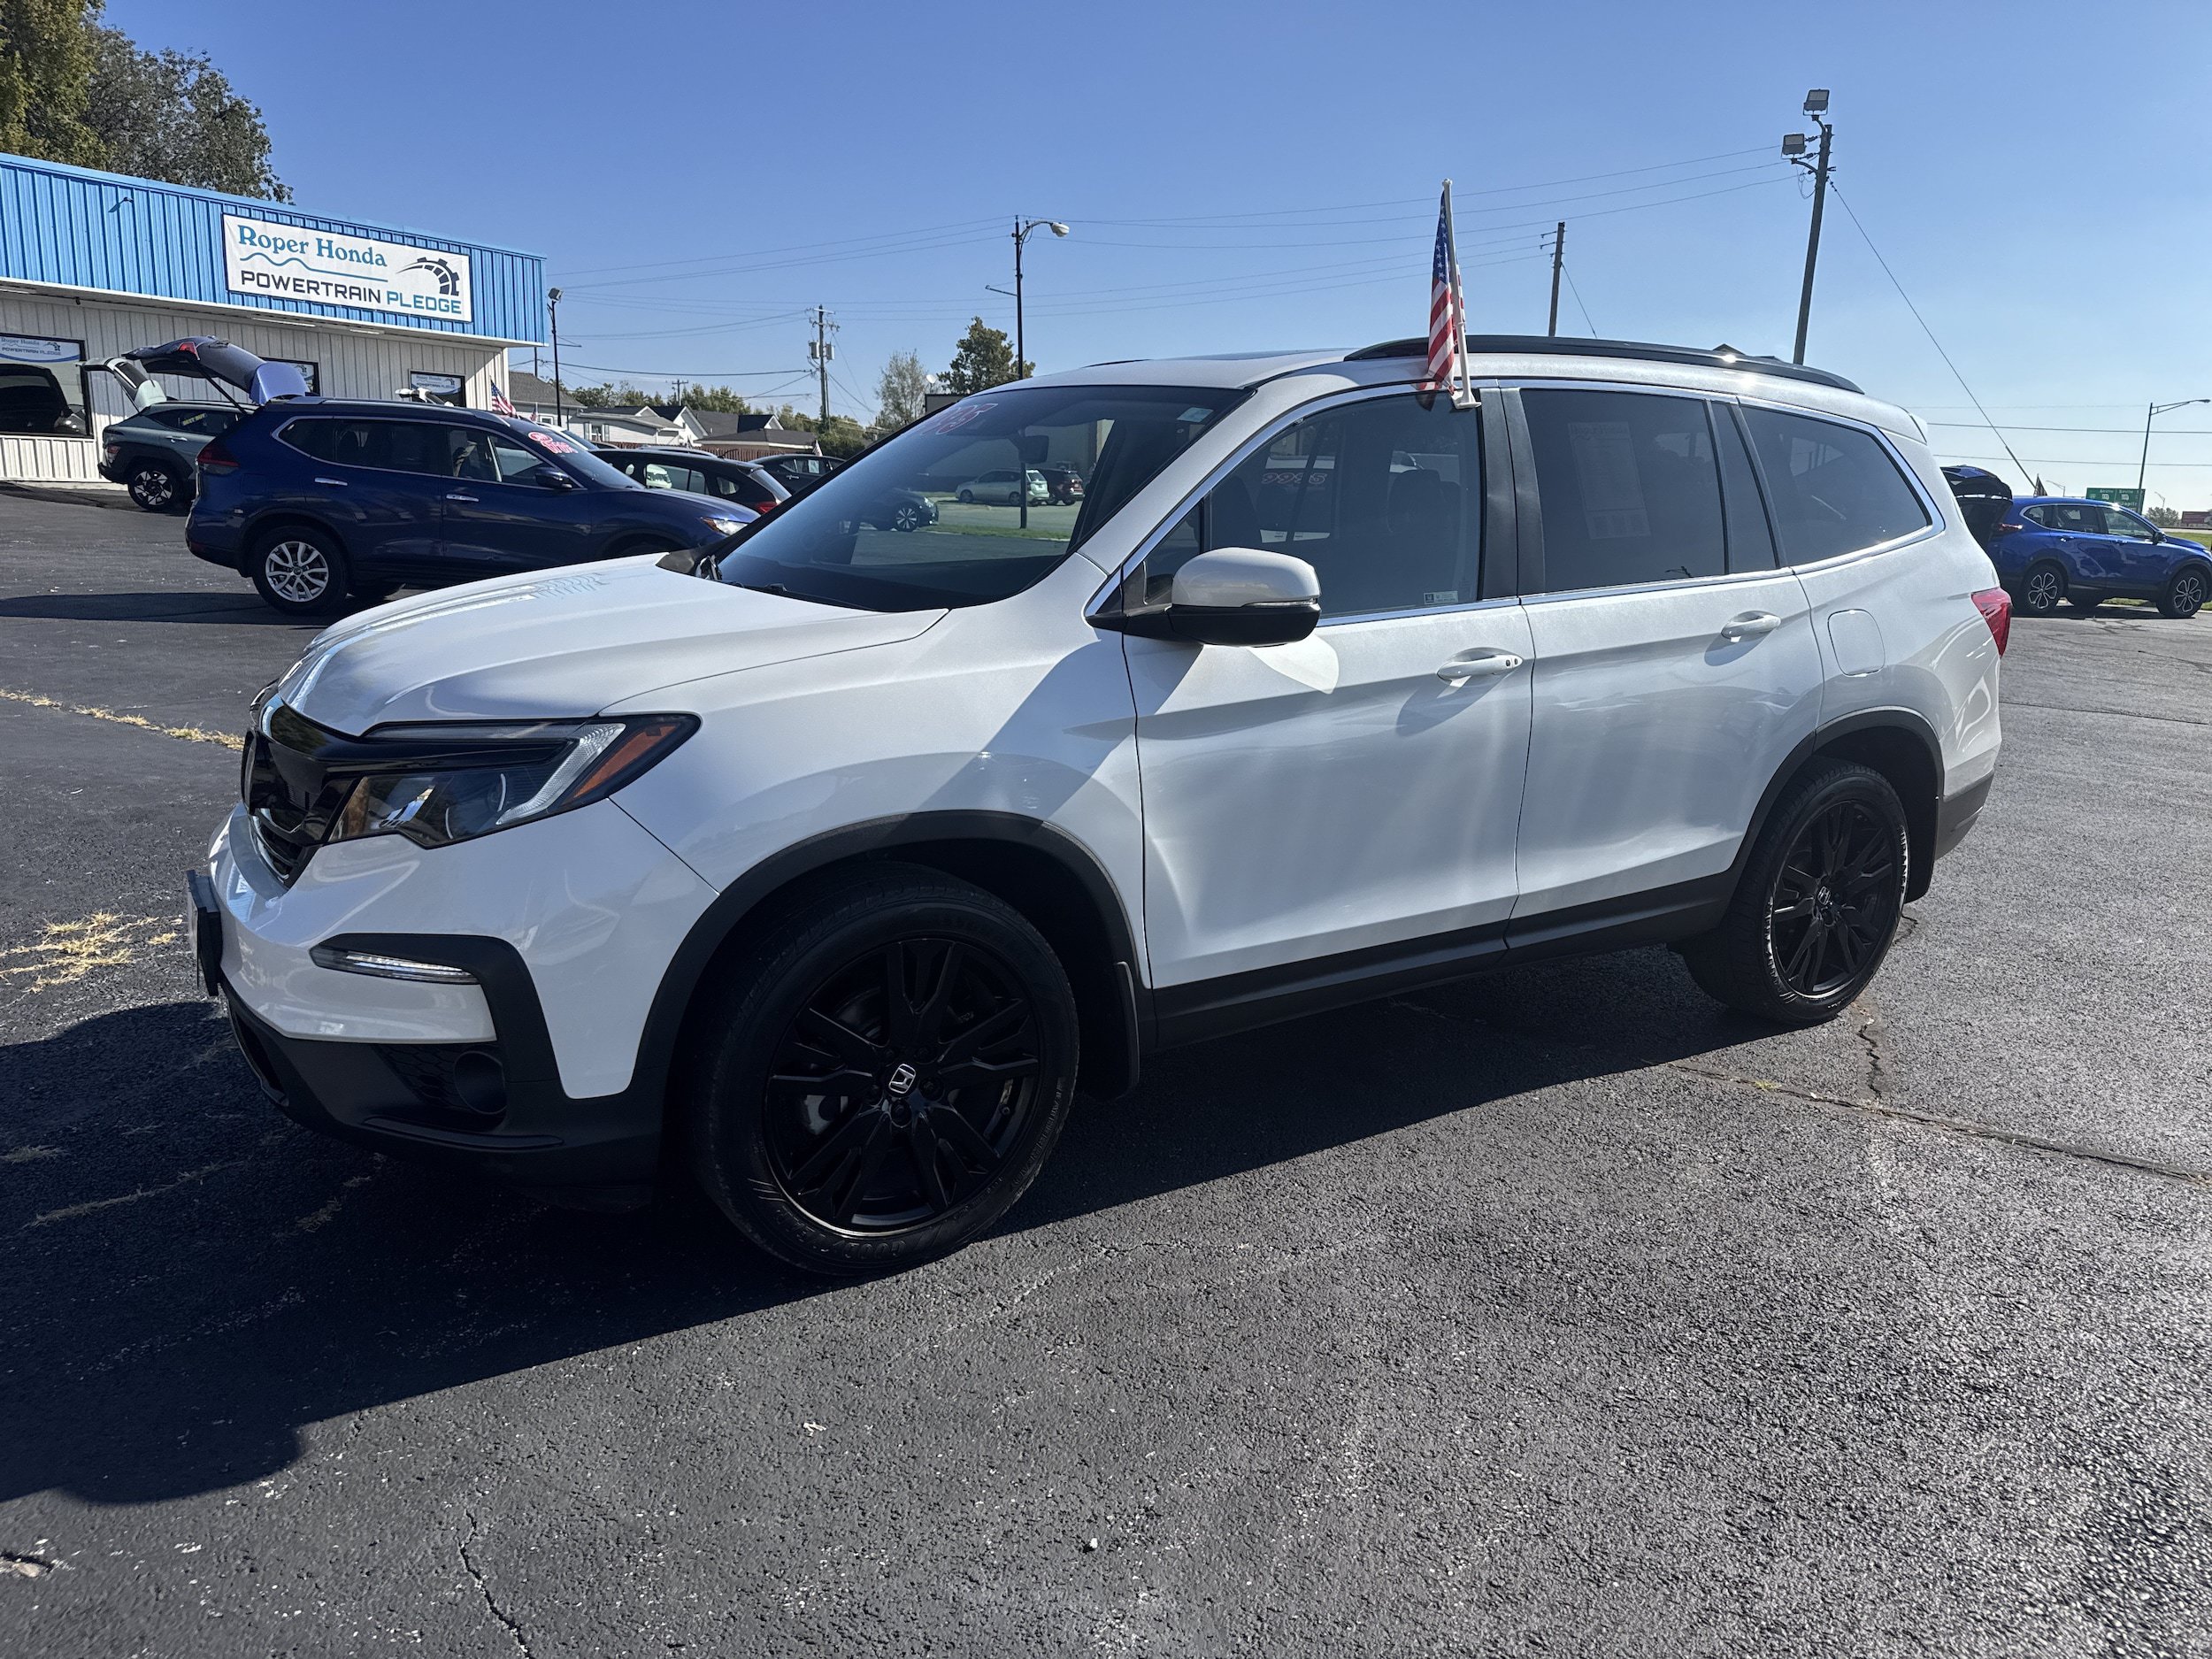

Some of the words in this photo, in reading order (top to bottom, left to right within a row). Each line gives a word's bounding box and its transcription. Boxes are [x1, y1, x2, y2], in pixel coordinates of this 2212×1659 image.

[238, 225, 309, 254] Roper
[315, 237, 388, 267] Honda
[241, 270, 381, 303] POWERTRAIN
[387, 290, 462, 314] PLEDGE
